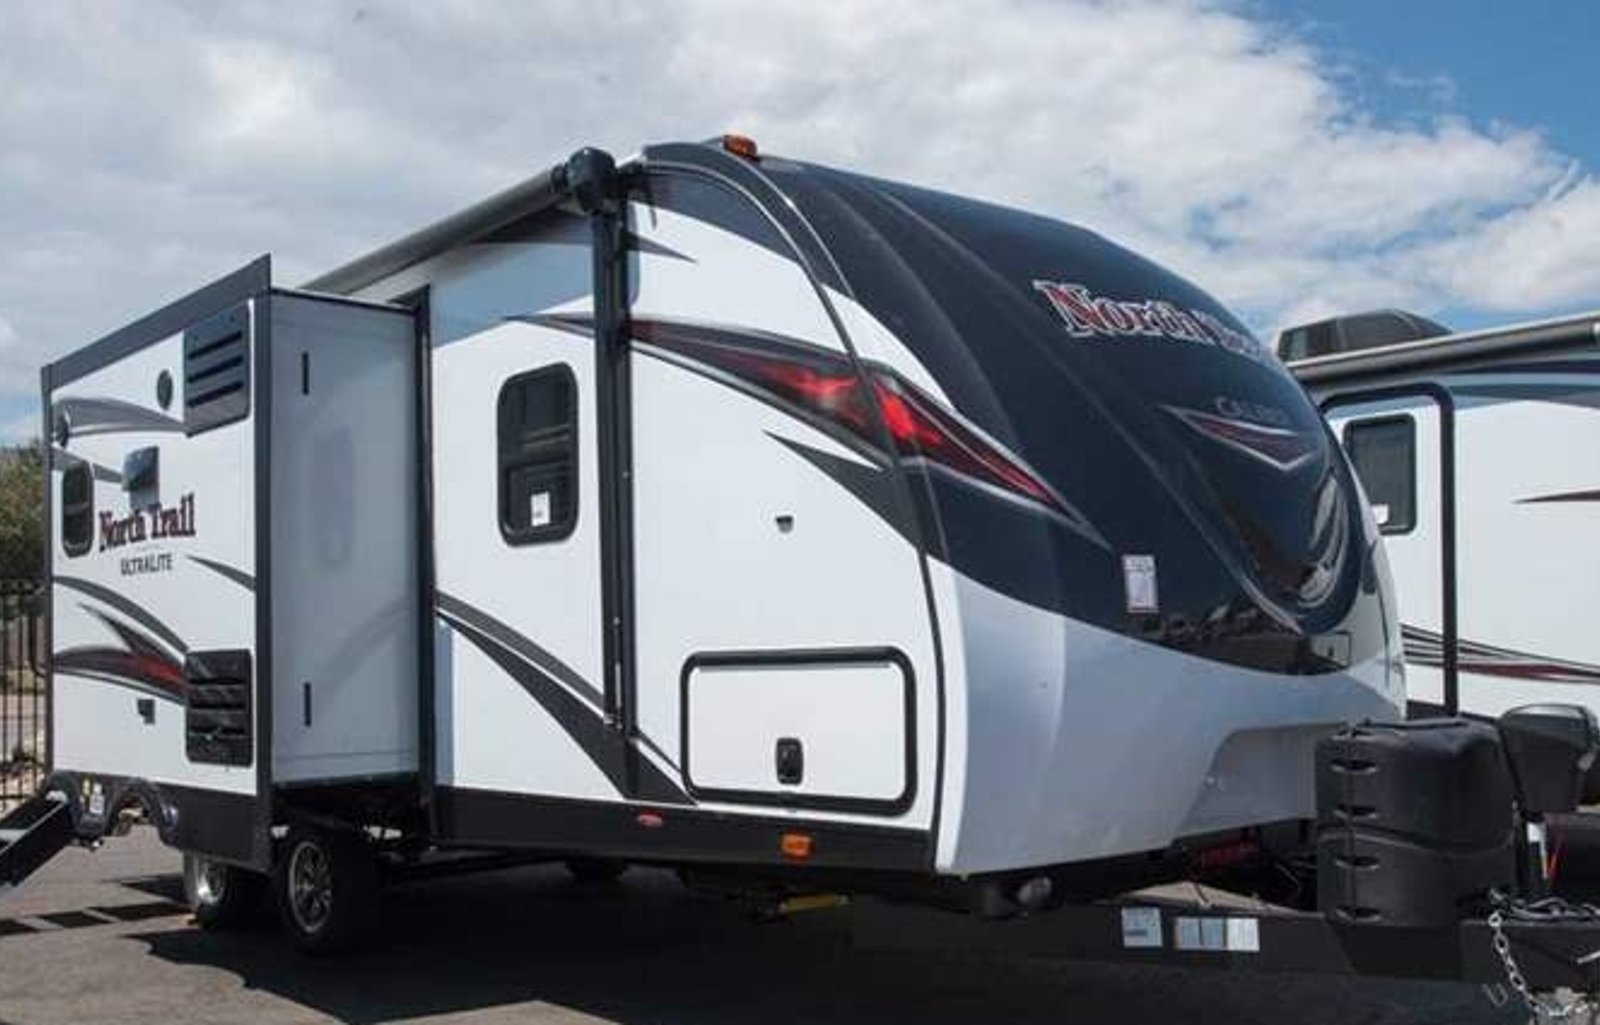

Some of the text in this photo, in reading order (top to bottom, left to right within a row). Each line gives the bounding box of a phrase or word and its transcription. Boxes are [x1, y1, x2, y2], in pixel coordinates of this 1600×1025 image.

[98, 492, 196, 553] North Trail
[120, 553, 173, 576] ULTRALITE
